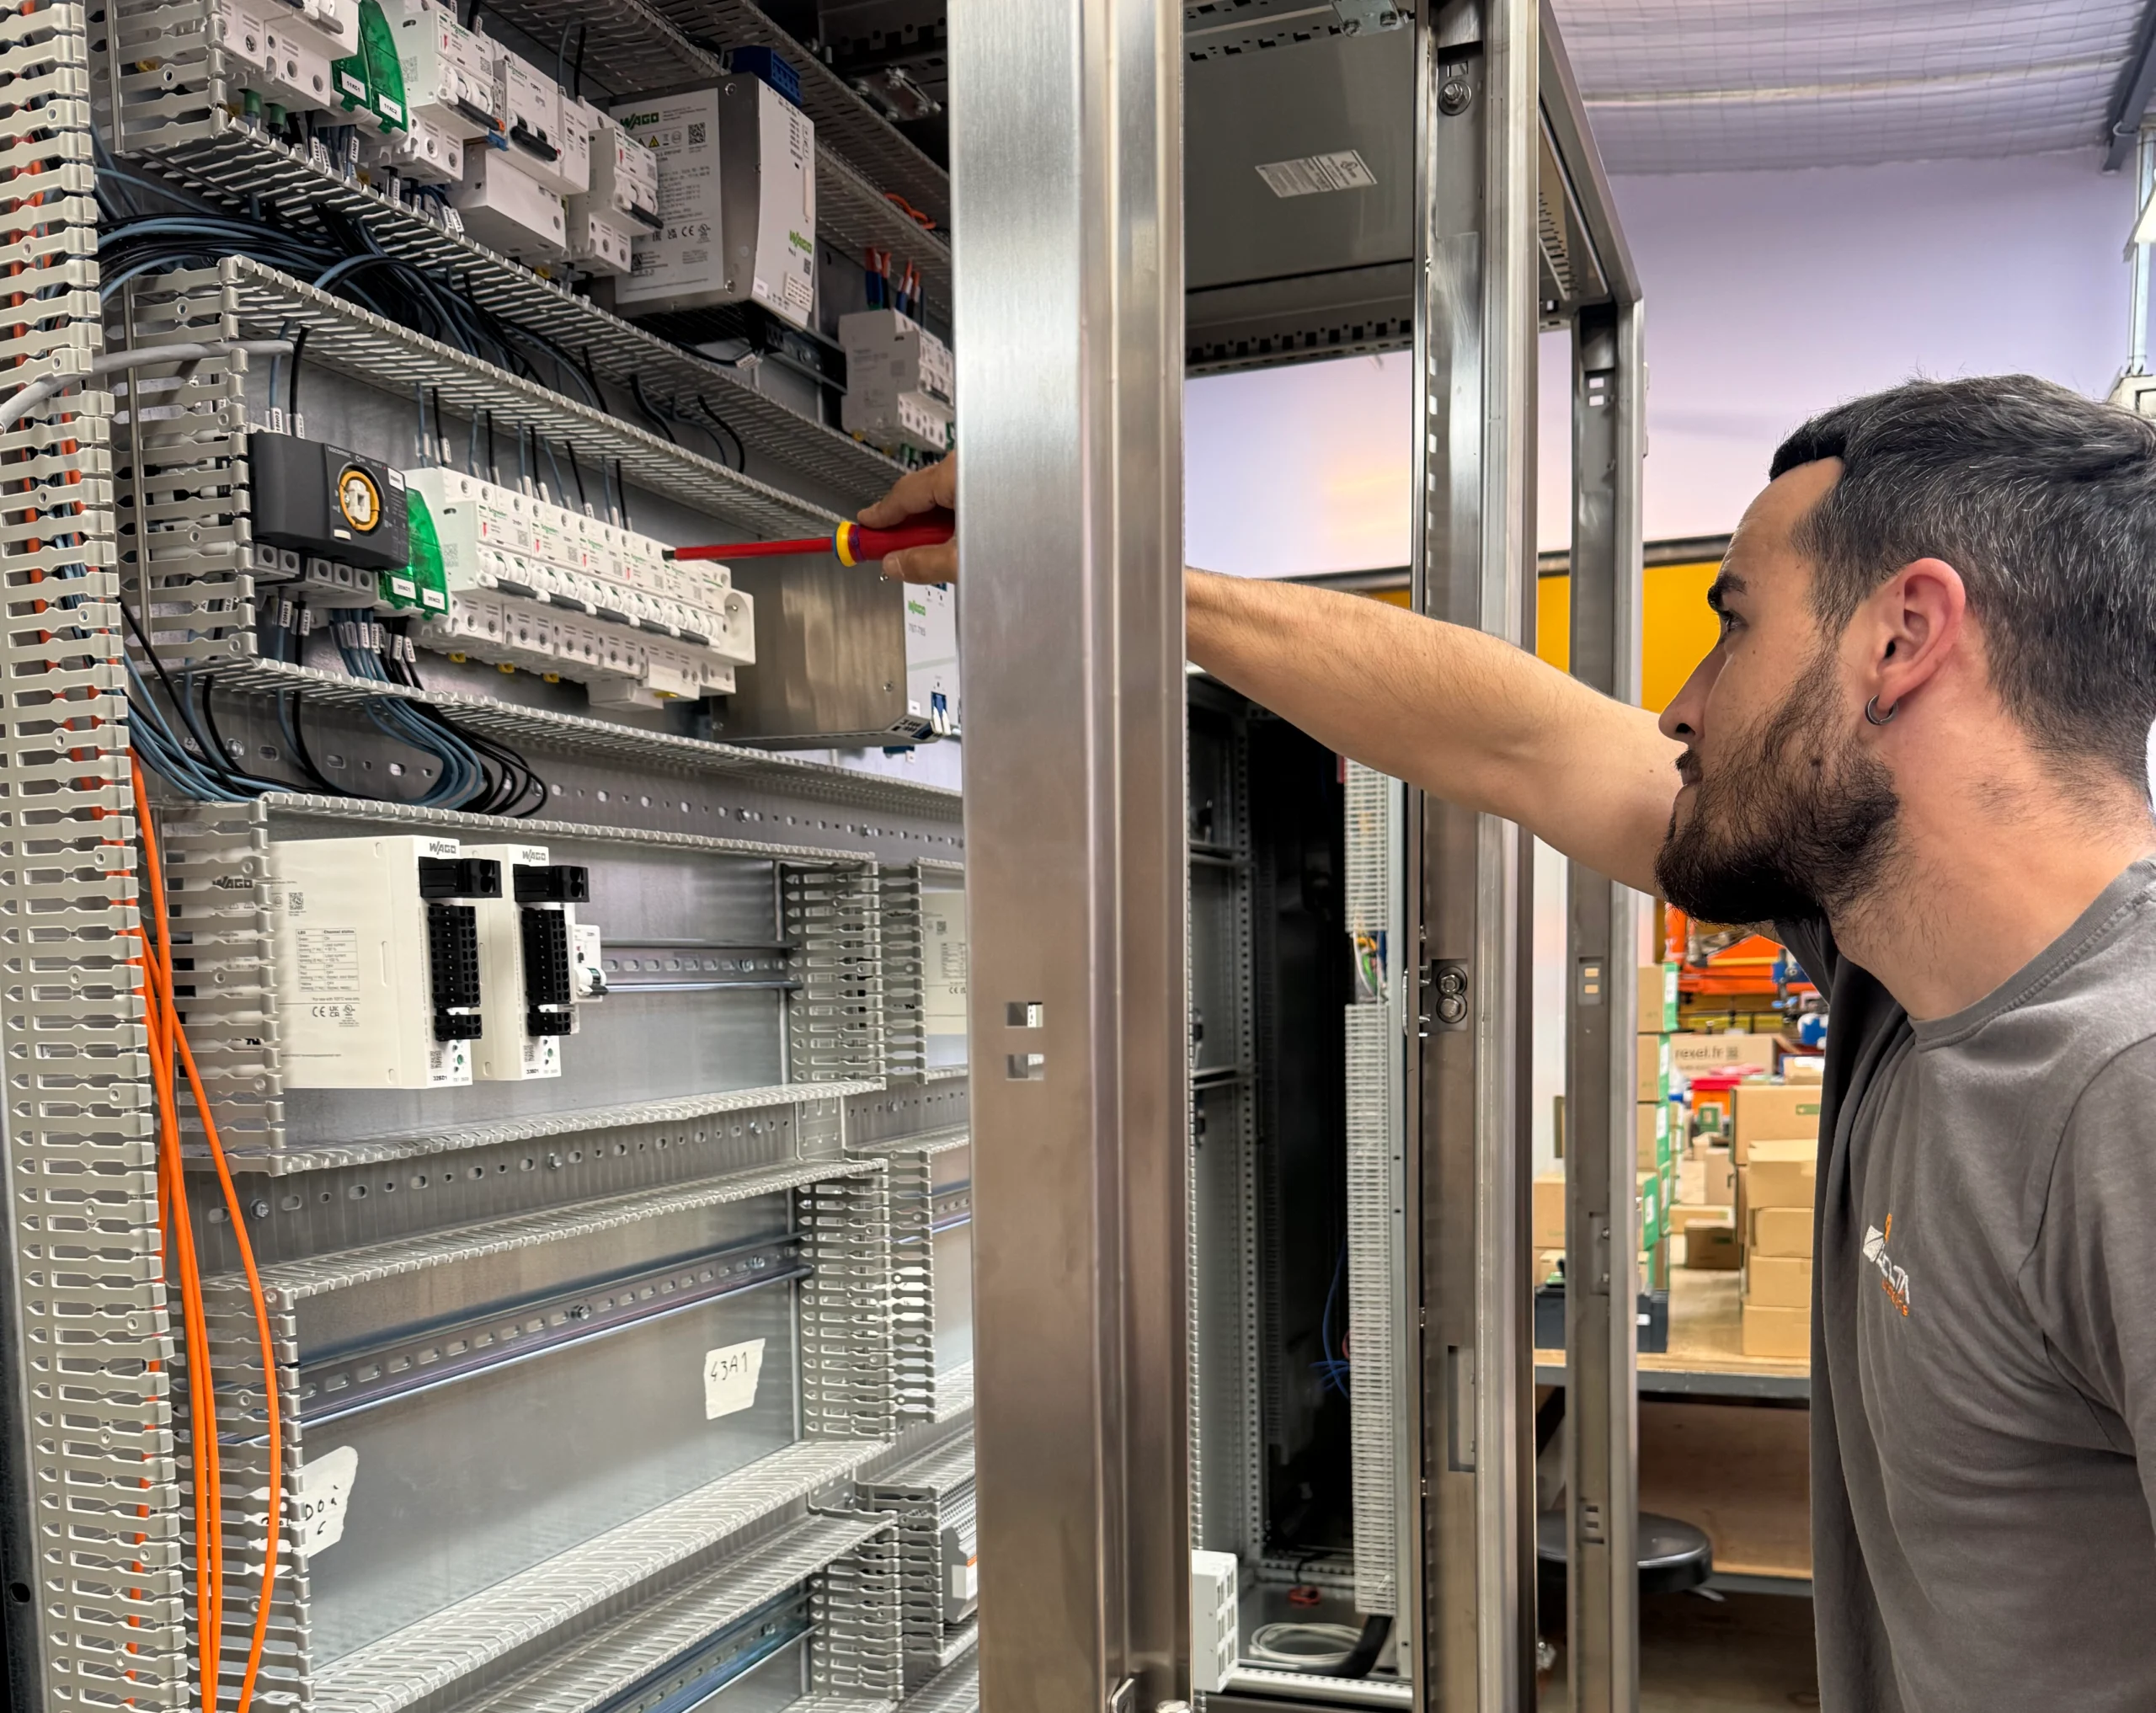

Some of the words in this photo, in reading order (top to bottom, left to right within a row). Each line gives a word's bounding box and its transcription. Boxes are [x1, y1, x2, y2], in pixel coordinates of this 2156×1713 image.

[280, 72, 286, 80] N
[620, 112, 659, 130] WAGO
[789, 230, 813, 255] WAGO
[429, 840, 456, 856] WAGO
[522, 849, 547, 862] WAGO
[312, 1006, 326, 1017] CE
[1674, 1046, 1723, 1059] rexel.fr
[710, 1351, 748, 1382] 43A1
